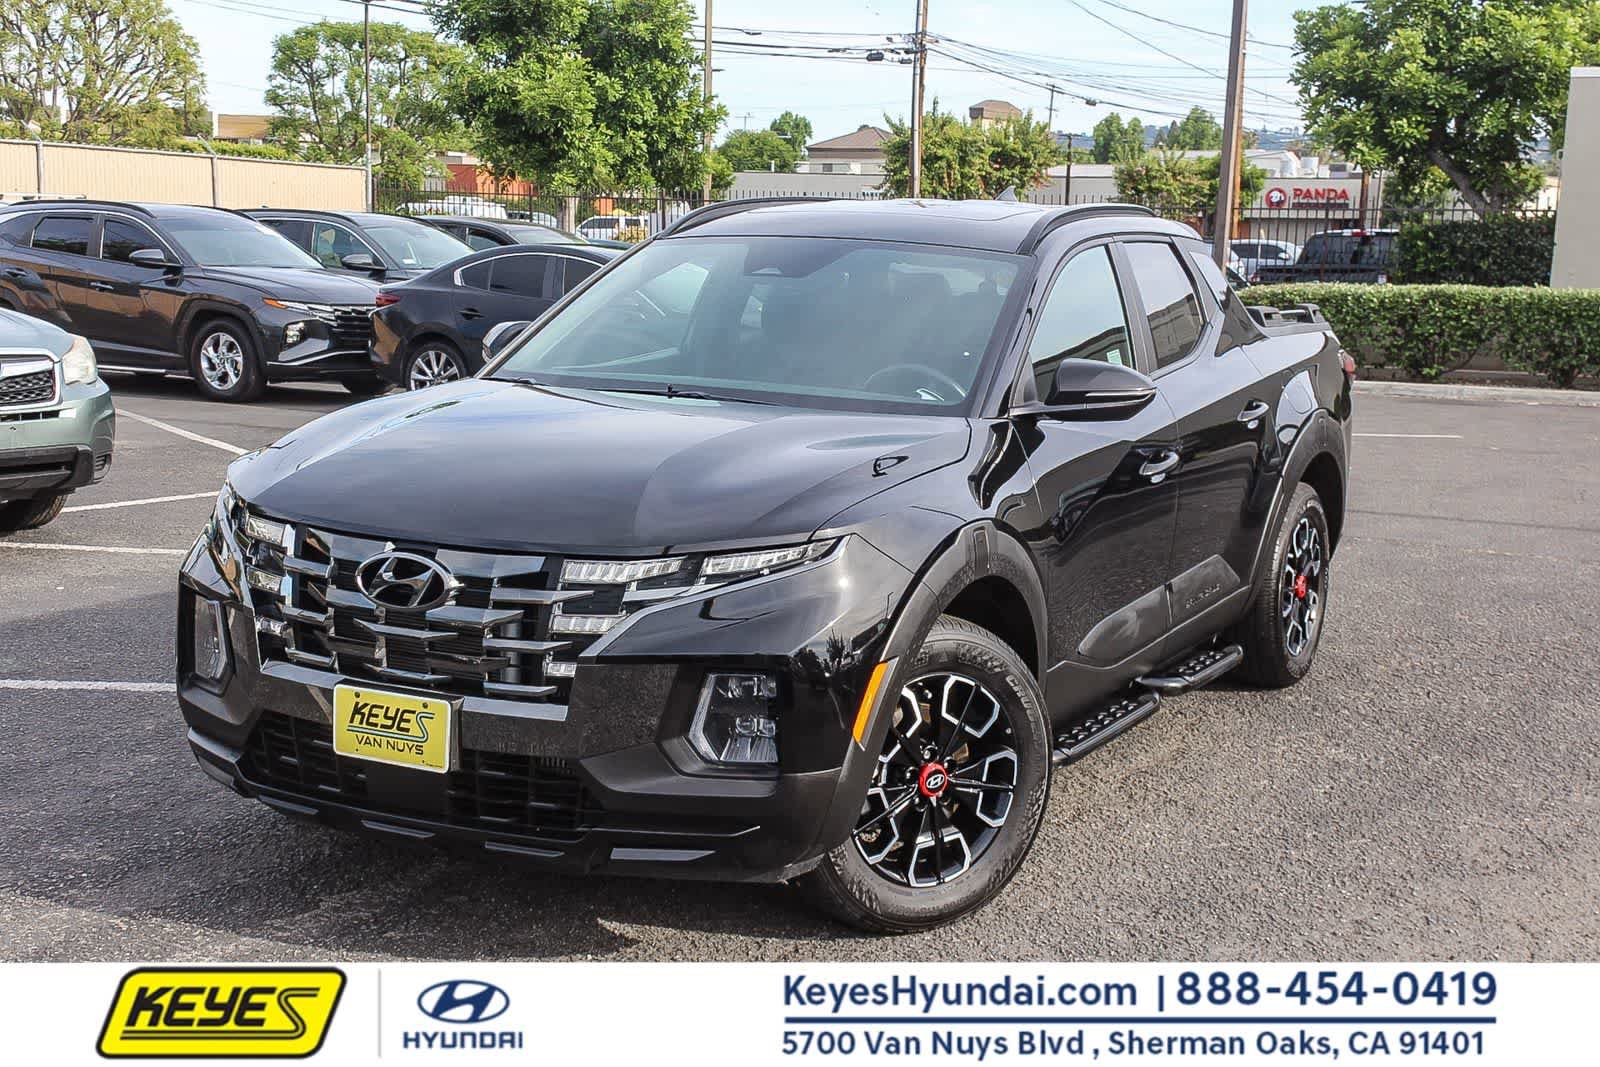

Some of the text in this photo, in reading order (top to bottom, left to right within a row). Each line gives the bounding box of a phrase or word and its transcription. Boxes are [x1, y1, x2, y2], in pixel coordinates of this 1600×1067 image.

[1293, 188, 1349, 201] PANDA
[347, 701, 435, 743] KEYES
[355, 734, 424, 756] VAN NUYS
